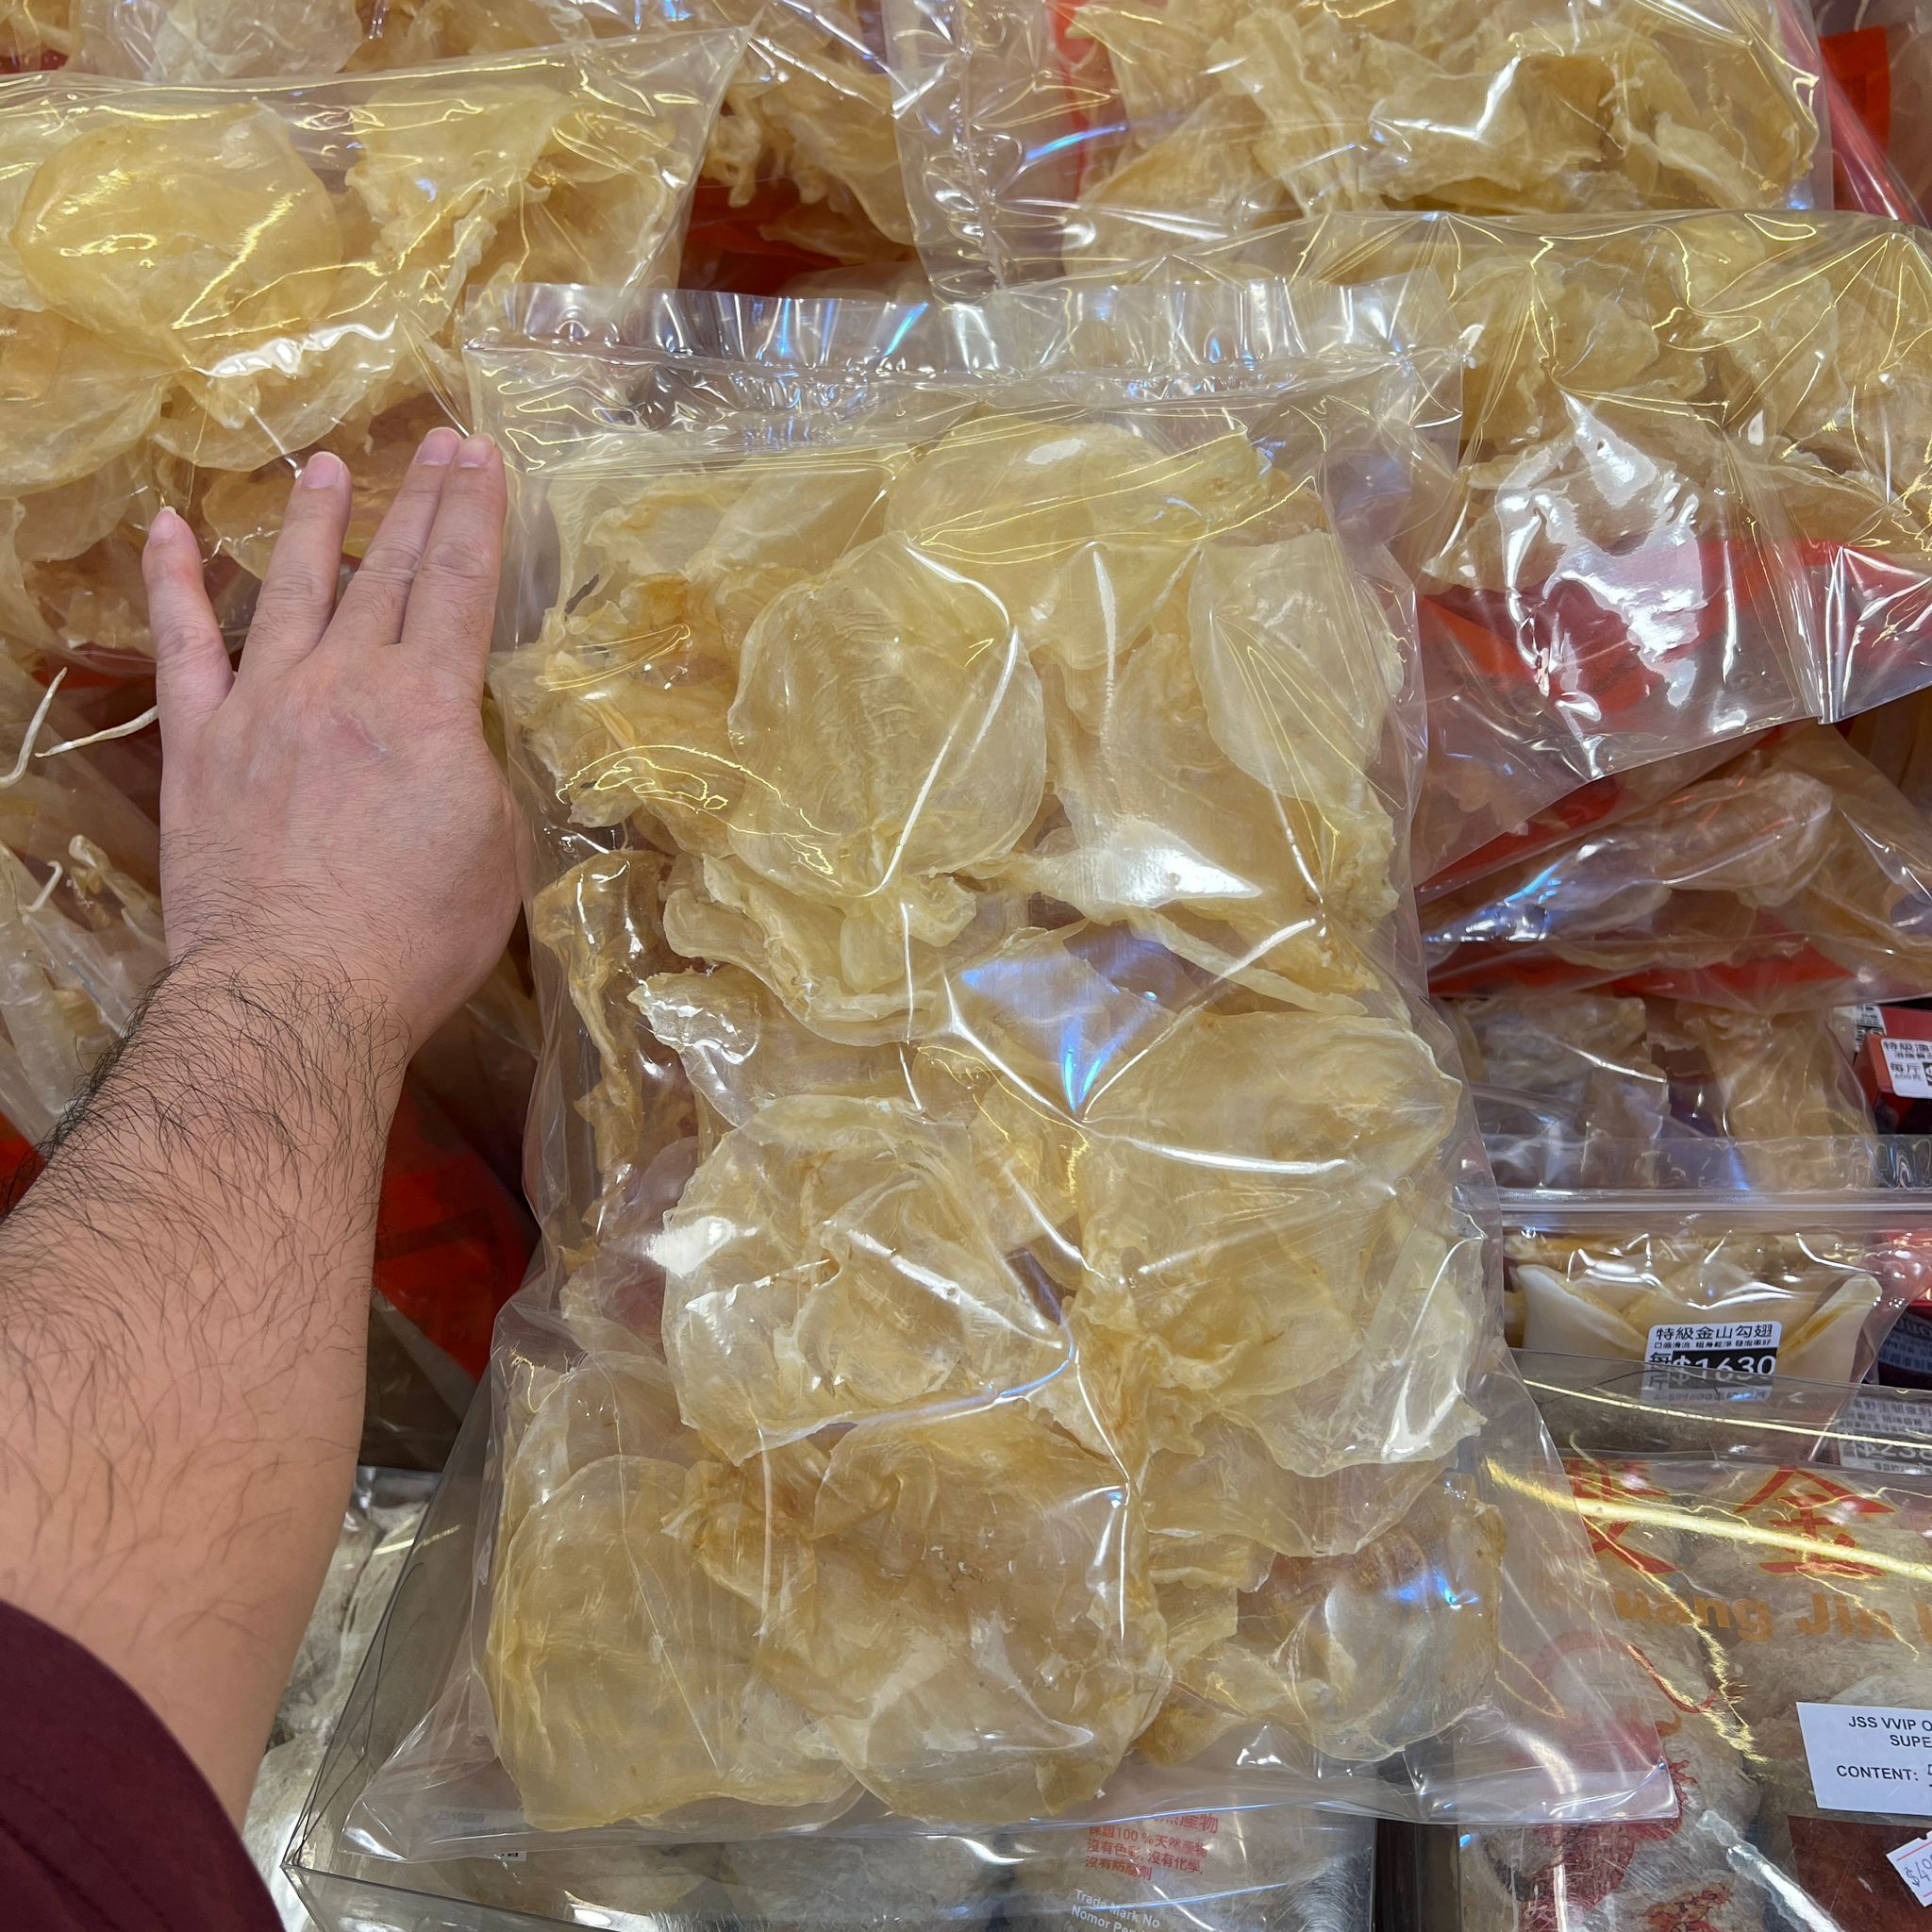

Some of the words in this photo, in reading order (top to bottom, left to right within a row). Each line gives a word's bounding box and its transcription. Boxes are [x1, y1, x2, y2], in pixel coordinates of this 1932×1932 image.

[1656, 1324, 1773, 1341] 特級金山勾翅
[1614, 1589, 1773, 1642] uang
[1848, 1716, 1878, 1728] JSS
[1881, 1717, 1917, 1731] VVIP
[1836, 1764, 1920, 1781] CONTENT:
[1071, 1905, 1111, 1929] Nomor
[1142, 1914, 1161, 1929] No
